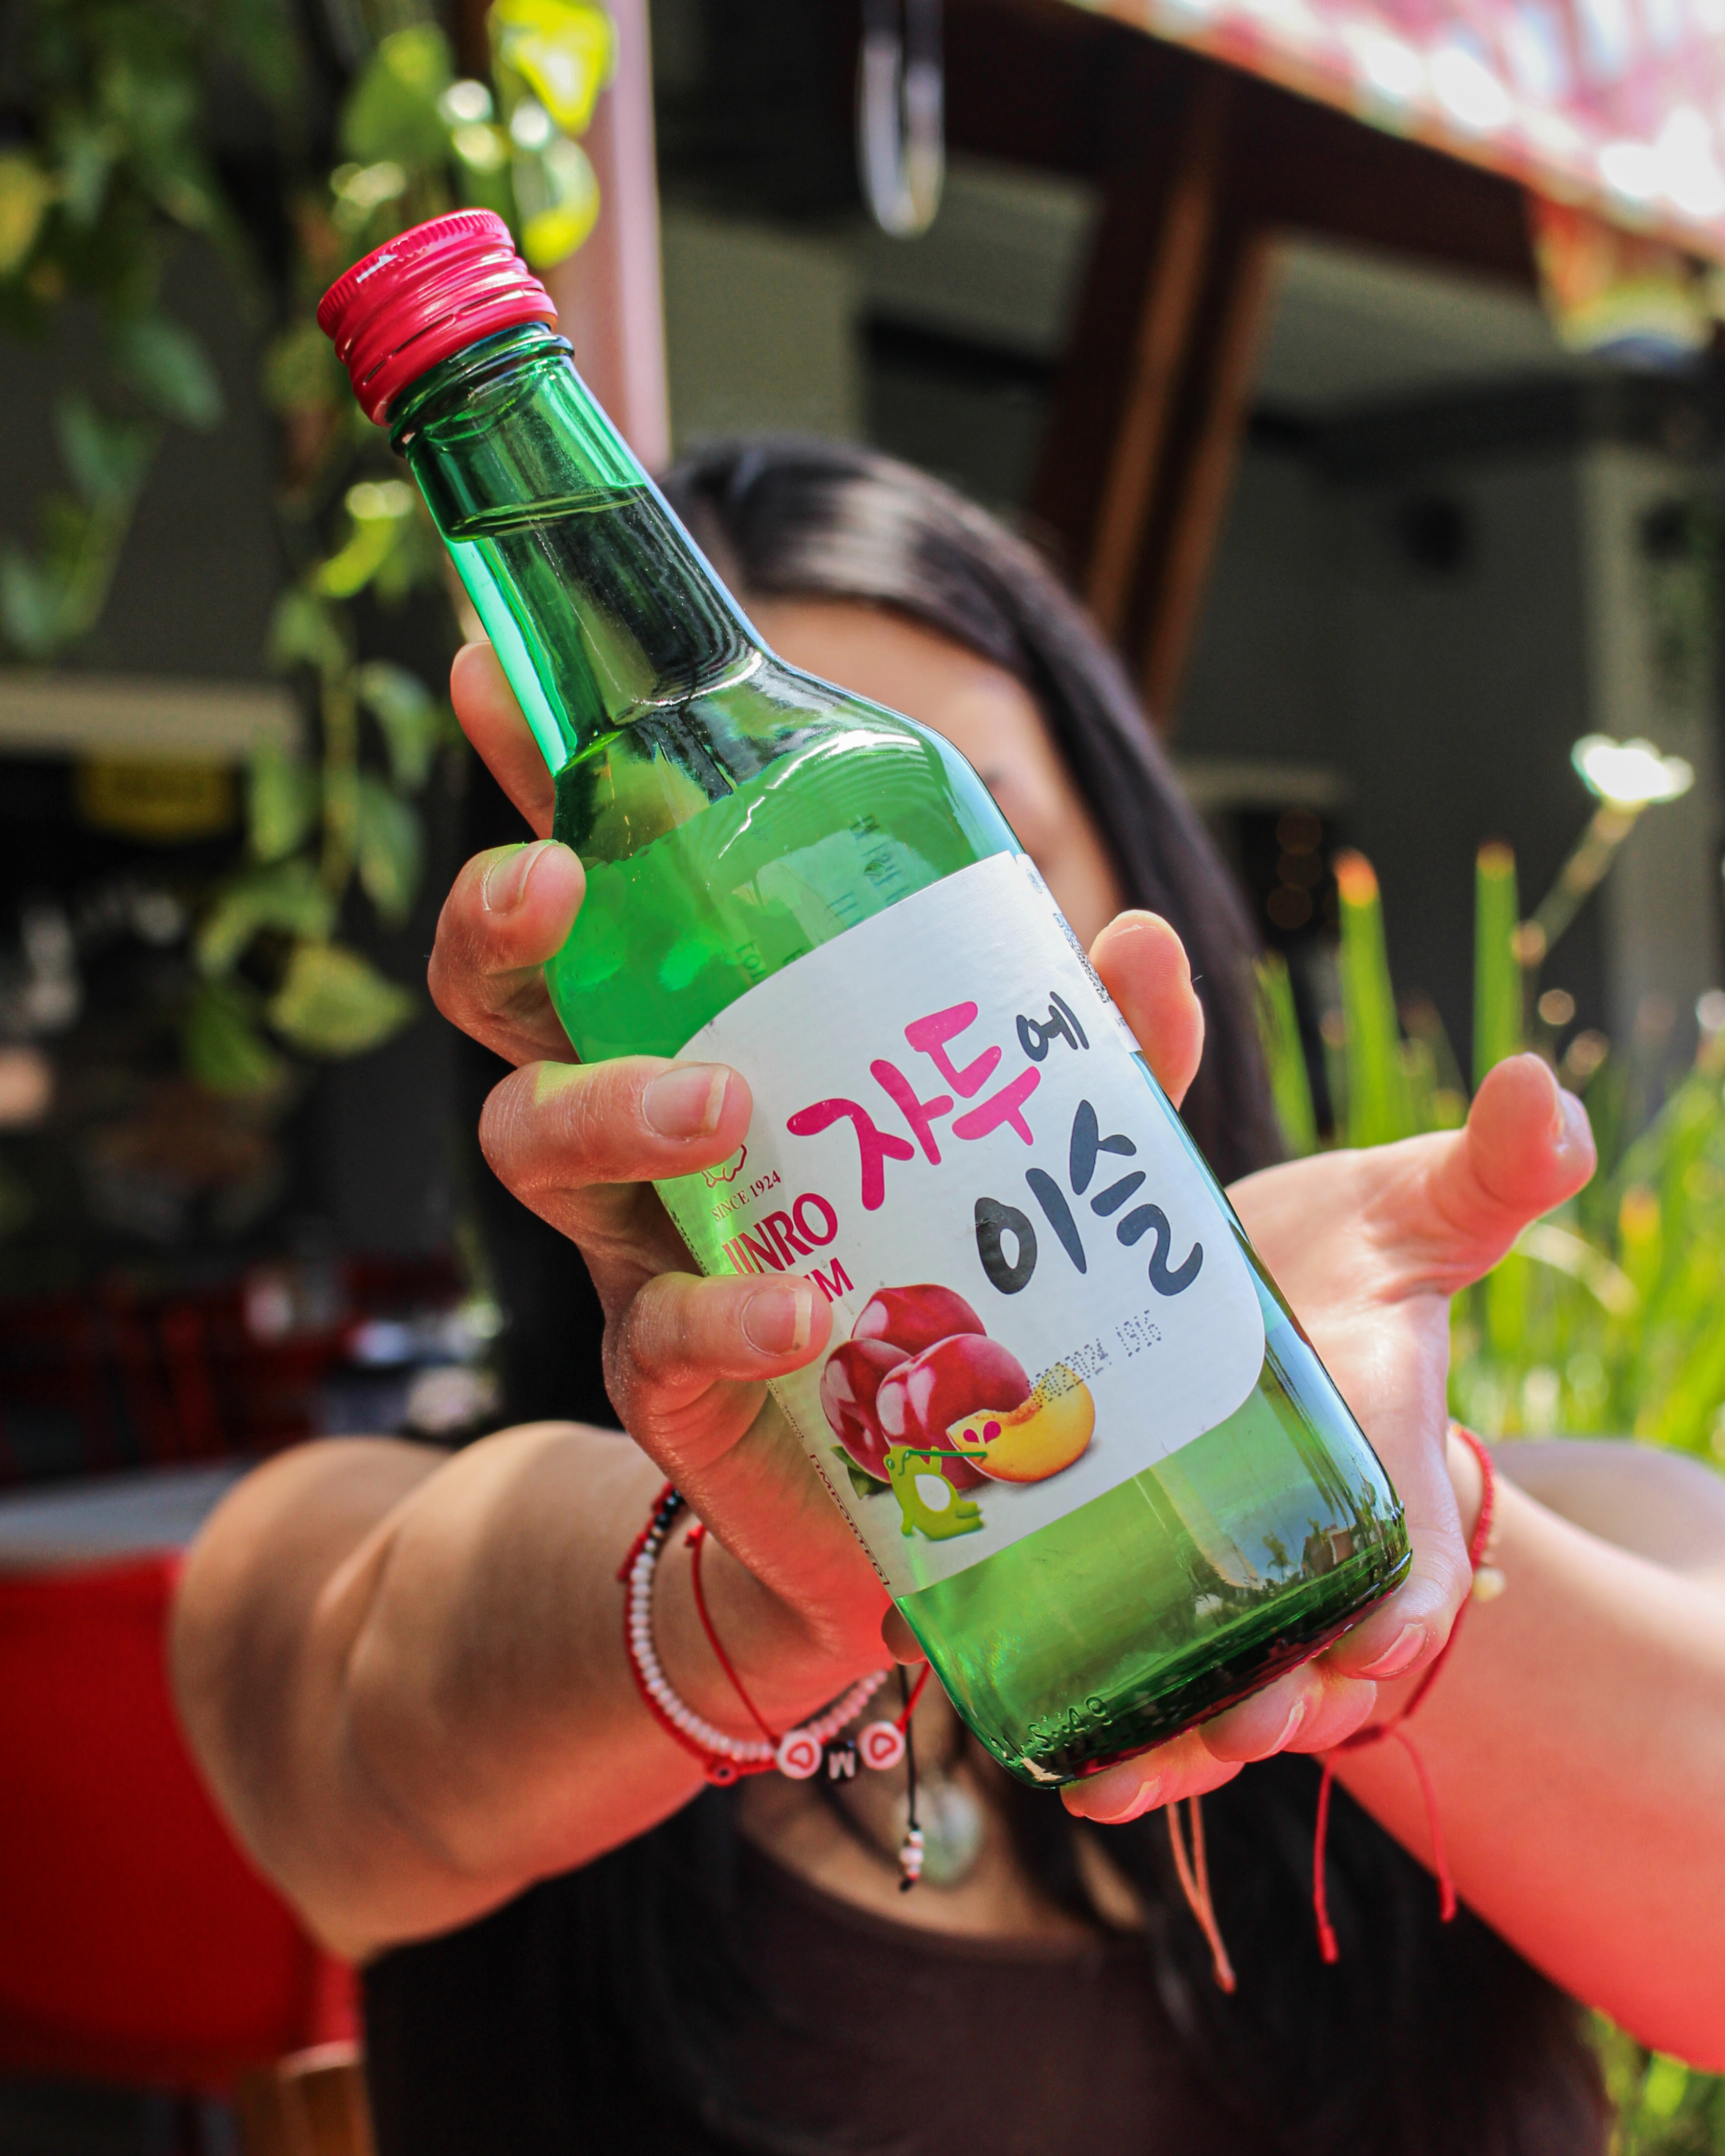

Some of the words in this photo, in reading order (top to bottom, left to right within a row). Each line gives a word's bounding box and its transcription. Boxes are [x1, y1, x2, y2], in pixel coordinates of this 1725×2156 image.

[787, 990, 1089, 1211] 자두에
[711, 1190, 750, 1222] SINCE
[749, 1170, 781, 1198] 1924
[975, 1100, 1204, 1296] 이슬
[815, 1464, 883, 1578] IMPORTED
[829, 1750, 855, 1779] M
